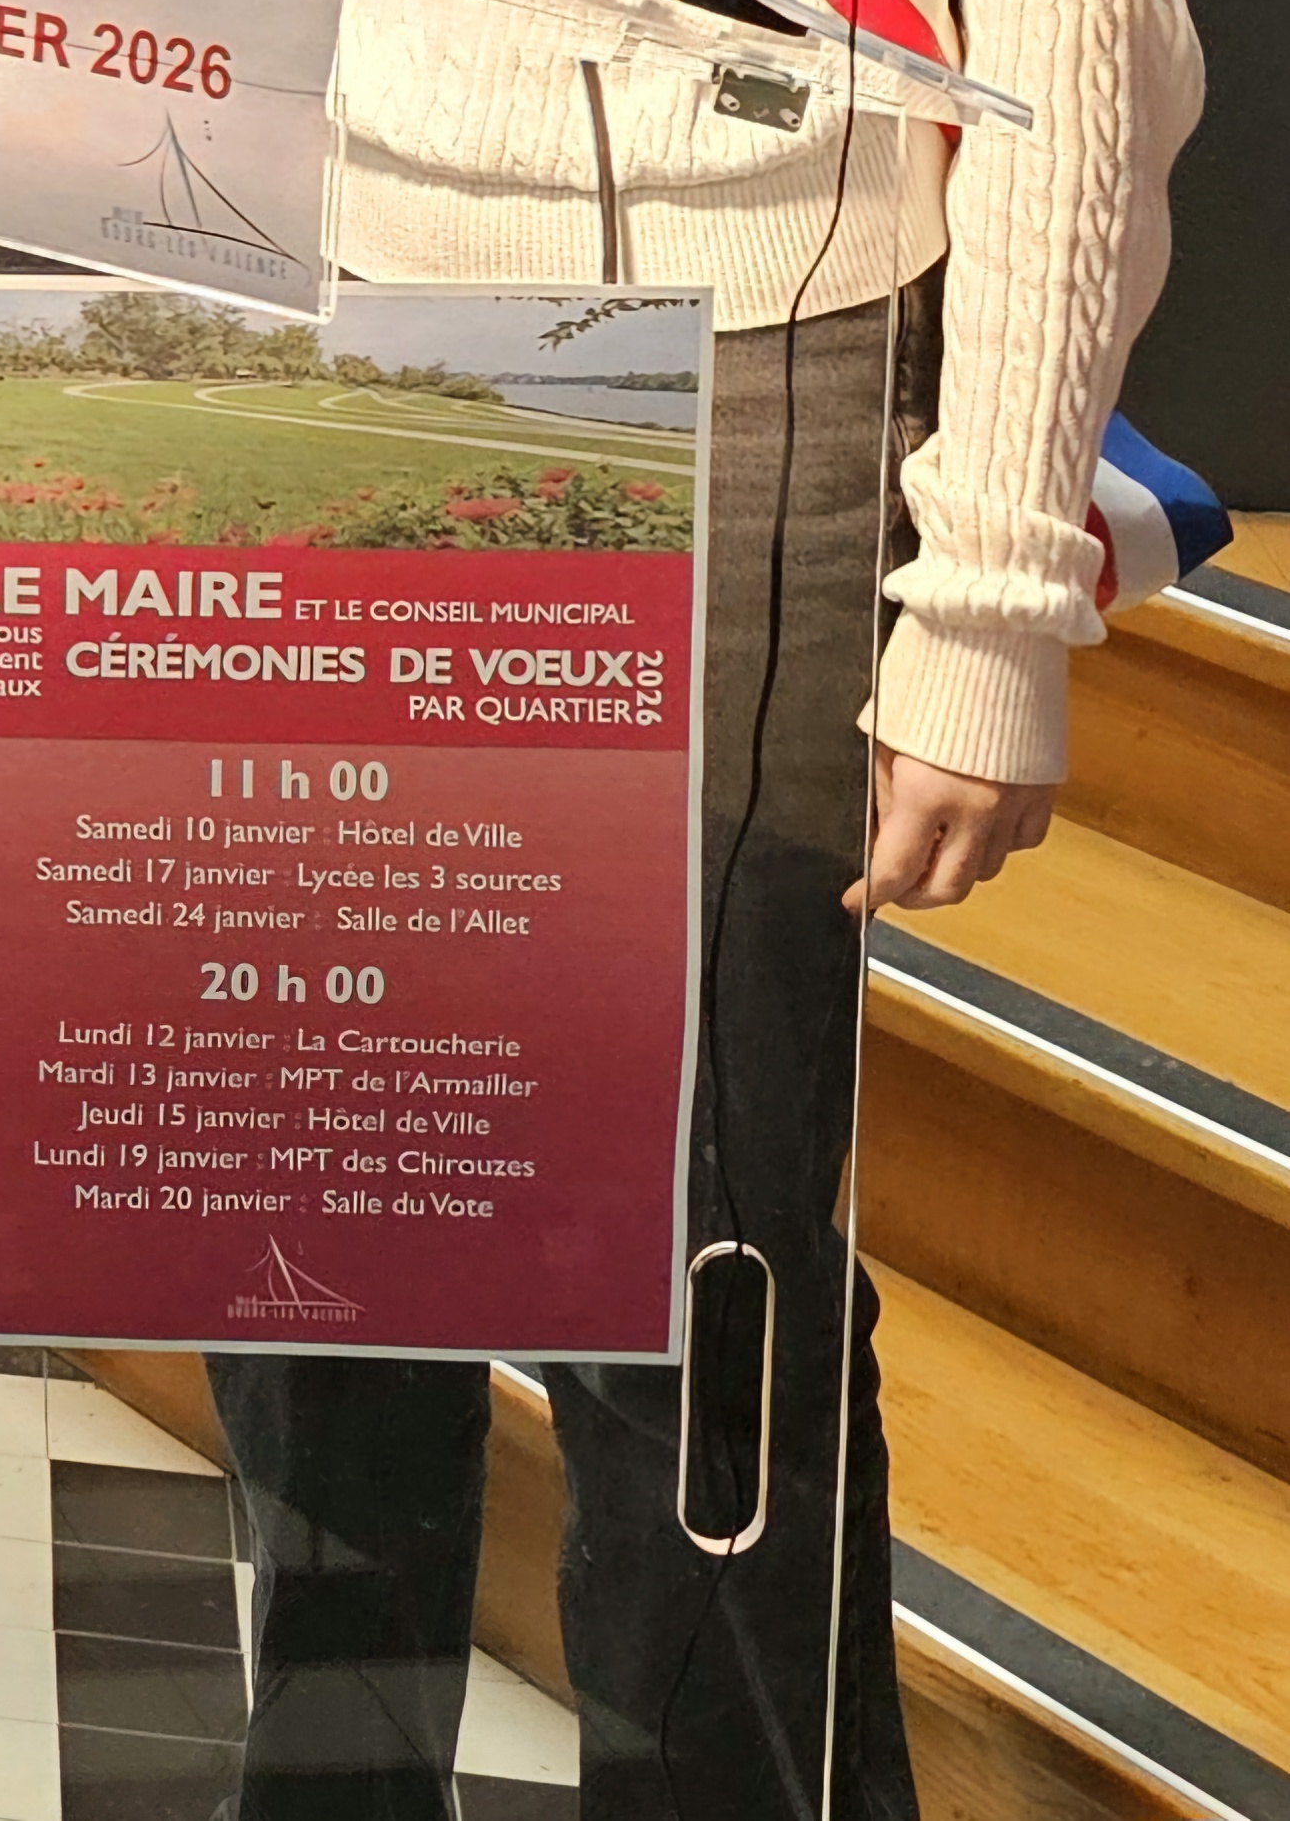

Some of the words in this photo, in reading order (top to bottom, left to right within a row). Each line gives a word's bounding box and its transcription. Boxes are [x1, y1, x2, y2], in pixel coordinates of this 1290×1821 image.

[90, 23, 231, 99] 2026
[65, 568, 283, 619] MAIRE
[295, 599, 328, 620] ET
[334, 600, 363, 620] LE
[370, 600, 483, 622] CONSEIL
[491, 602, 635, 624] MUNICIPAL
[66, 632, 365, 682] CÉRÉMONIES
[390, 648, 453, 683] DE
[469, 648, 634, 688] VOEUX
[636, 650, 664, 726] 2026
[409, 695, 465, 720] PAR
[476, 697, 633, 725] QUARTIER
[281, 760, 310, 799] h
[329, 760, 388, 801] 00
[76, 814, 171, 841] Samedi
[187, 817, 215, 841] 10
[224, 819, 315, 848] janvier
[338, 819, 415, 846] Hôtel
[425, 822, 459, 846] de
[463, 823, 523, 848] Ville
[36, 857, 132, 883] Samedi
[146, 858, 175, 883] 17
[185, 861, 275, 890] janvier
[298, 862, 375, 894] Lycée
[384, 864, 420, 889] les
[430, 865, 445, 889] 3
[456, 873, 562, 891] sources
[66, 900, 162, 925] Samedi
[173, 903, 206, 927] 24
[214, 905, 306, 934] janvier
[337, 907, 397, 931] Salle
[408, 909, 441, 932] de
[450, 909, 529, 934] l'Allet
[200, 962, 259, 1001] 20
[277, 965, 306, 1002] h
[325, 965, 385, 1004] 00
[59, 1021, 132, 1046] Lundi
[147, 1024, 175, 1047] 12
[184, 1026, 275, 1055] janvier
[297, 1028, 325, 1051] La
[338, 1029, 521, 1057] Cartoucherie
[39, 1060, 114, 1084] Mardi
[130, 1062, 156, 1086] 13
[166, 1066, 257, 1093] janvier
[281, 1067, 343, 1090] MPT
[352, 1069, 385, 1092] de
[396, 1070, 539, 1097] l'Armailler
[77, 1101, 143, 1132] Jeudi
[159, 1103, 185, 1126] 15
[196, 1105, 286, 1133] janvier
[308, 1106, 385, 1132] Hôtel
[396, 1109, 428, 1133] de
[432, 1111, 491, 1135] Ville
[33, 1141, 105, 1167] Lundi
[120, 1144, 148, 1167] 19
[157, 1144, 248, 1174] janvier
[271, 1146, 333, 1171] MPT
[342, 1149, 387, 1173] des
[397, 1150, 535, 1177] Chirouzes
[75, 1185, 149, 1210] Mardi
[160, 1186, 192, 1210] 20
[202, 1188, 292, 1217] janvier
[321, 1189, 382, 1214] Salle
[392, 1191, 424, 1215] du
[429, 1192, 493, 1217] Vote
